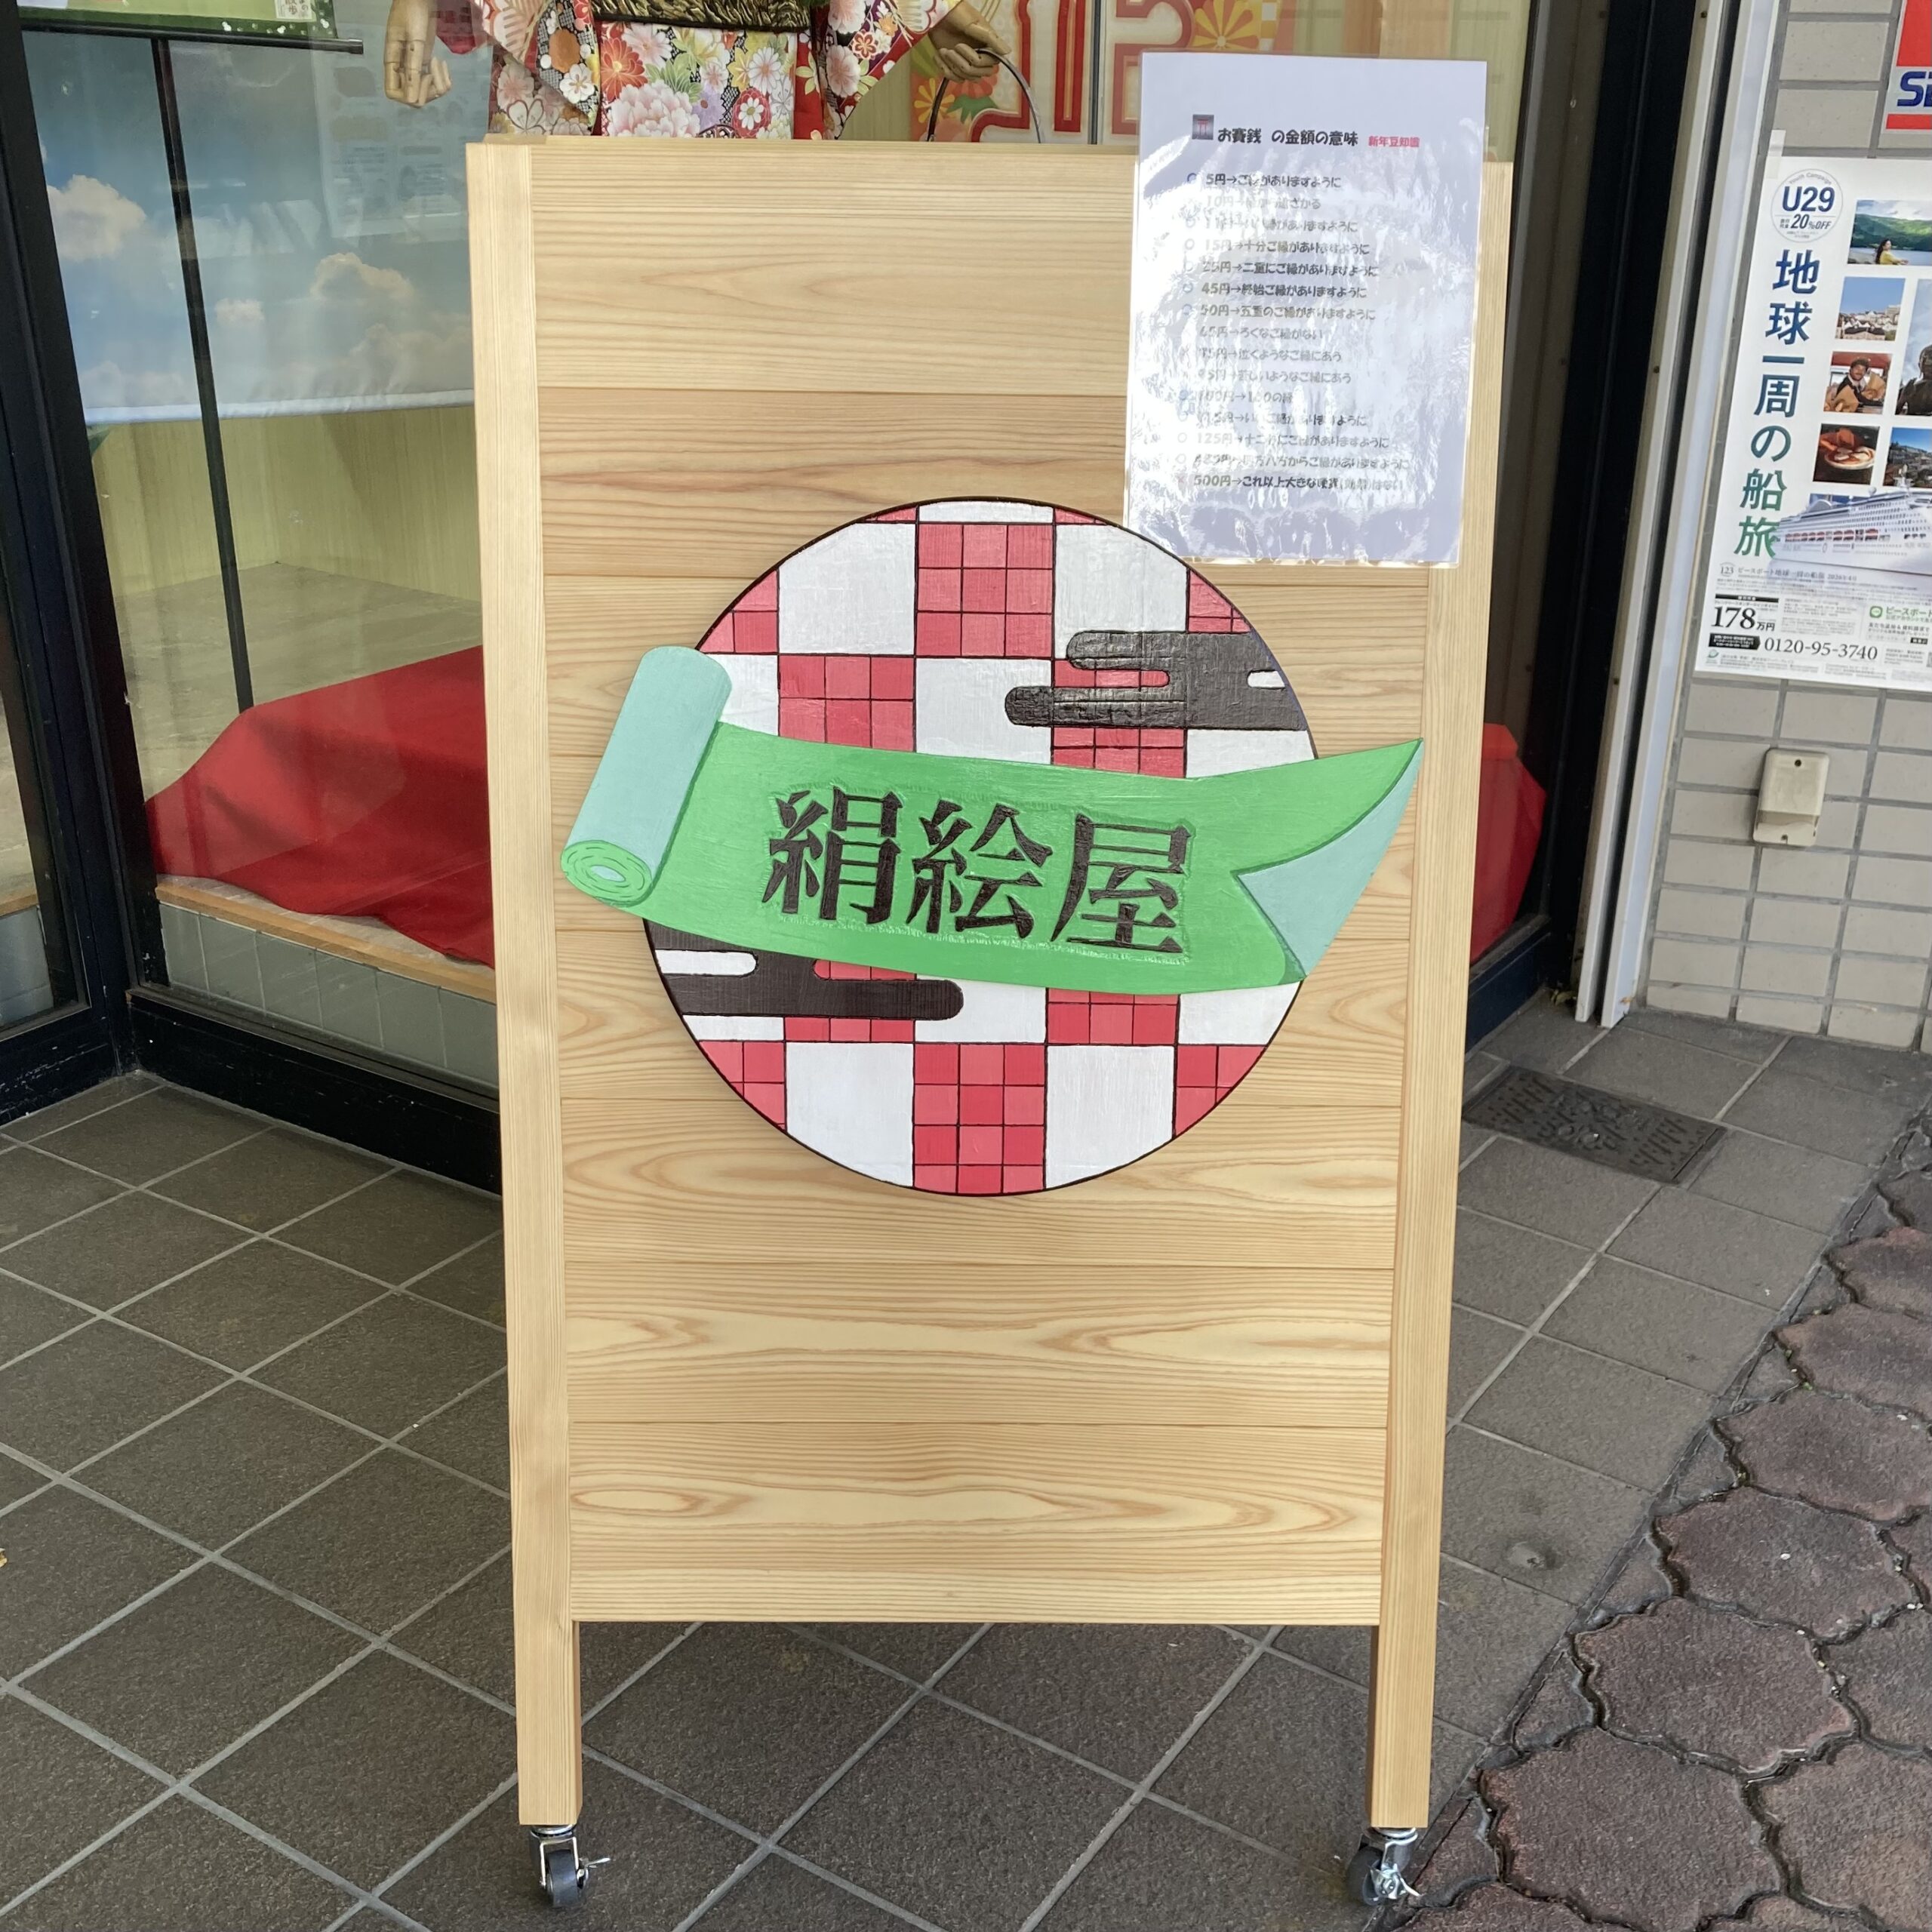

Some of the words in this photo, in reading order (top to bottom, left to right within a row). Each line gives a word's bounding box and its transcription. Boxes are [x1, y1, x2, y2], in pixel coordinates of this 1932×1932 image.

[1896, 71, 1932, 107] S
[1217, 128, 1262, 144] お賽銭
[1272, 129, 1358, 147] の金額の意味
[1782, 186, 1835, 212] U29
[1734, 249, 1820, 559] 地球一周の船旅
[1764, 636, 1878, 661] 0120-95-3740
[761, 786, 1192, 954] 絹絵屋
